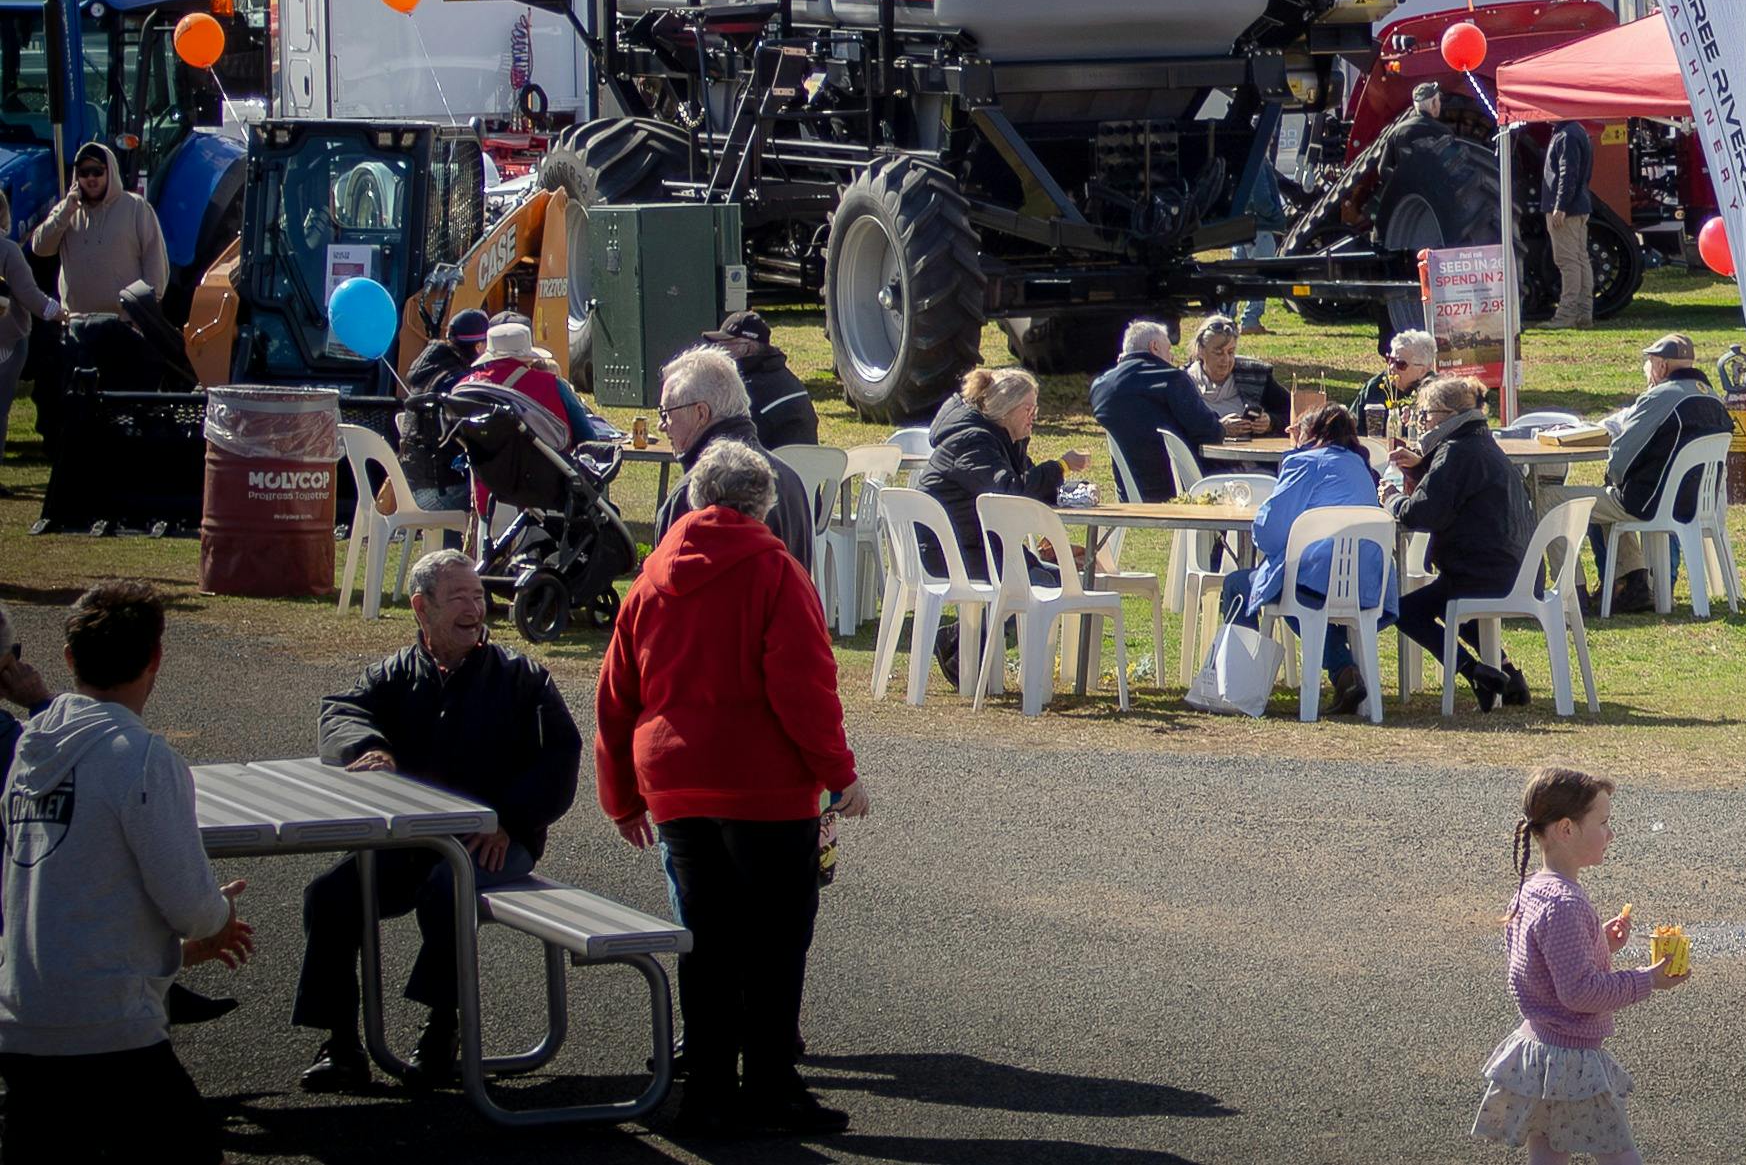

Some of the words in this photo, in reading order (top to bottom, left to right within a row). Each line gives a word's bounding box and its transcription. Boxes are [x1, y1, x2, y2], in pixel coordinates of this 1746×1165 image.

[478, 223, 516, 291] CASE
[1439, 260, 1472, 274] SEED
[1474, 259, 1488, 270] IN
[1435, 274, 1478, 287] SPEND
[1481, 273, 1495, 284] IN
[1435, 303, 1473, 317] 2027!
[248, 471, 330, 489] MOLYCOP
